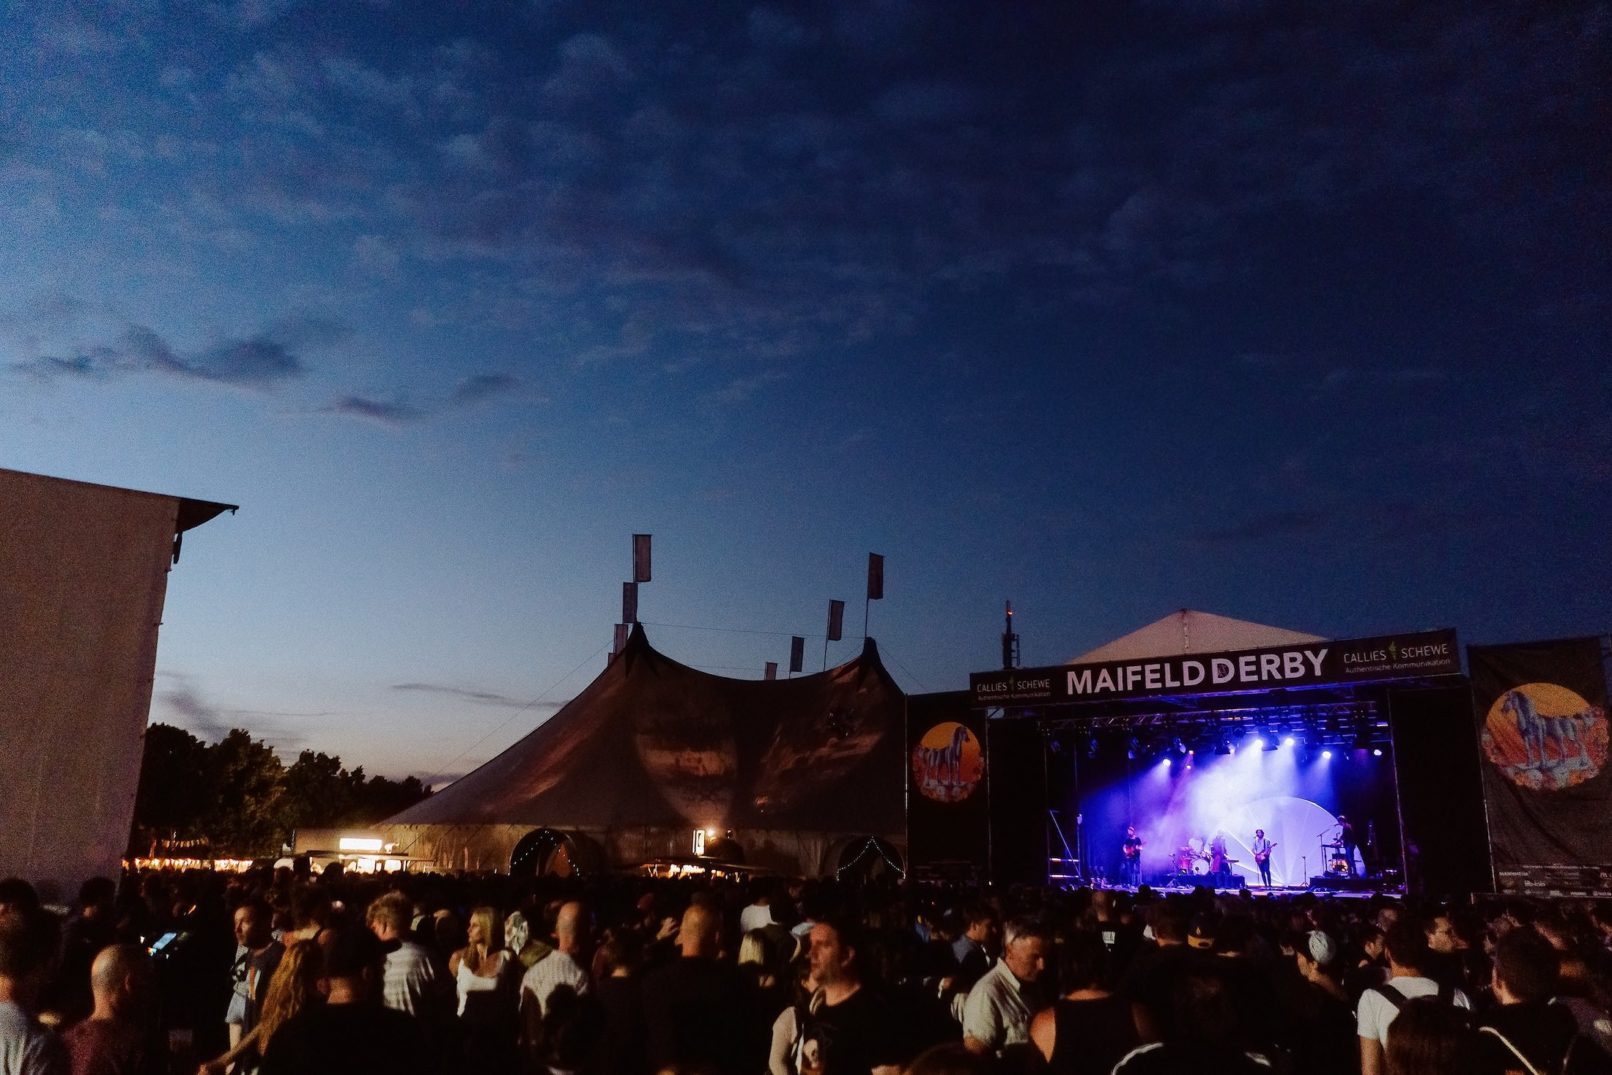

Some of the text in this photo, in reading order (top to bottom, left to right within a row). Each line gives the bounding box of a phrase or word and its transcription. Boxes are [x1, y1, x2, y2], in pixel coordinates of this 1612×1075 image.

[1343, 643, 1449, 664] CALLIES SCHEWE
[1067, 649, 1328, 695] MAIFELD DERBY
[977, 679, 1051, 693] CALLIES SCHEWE
